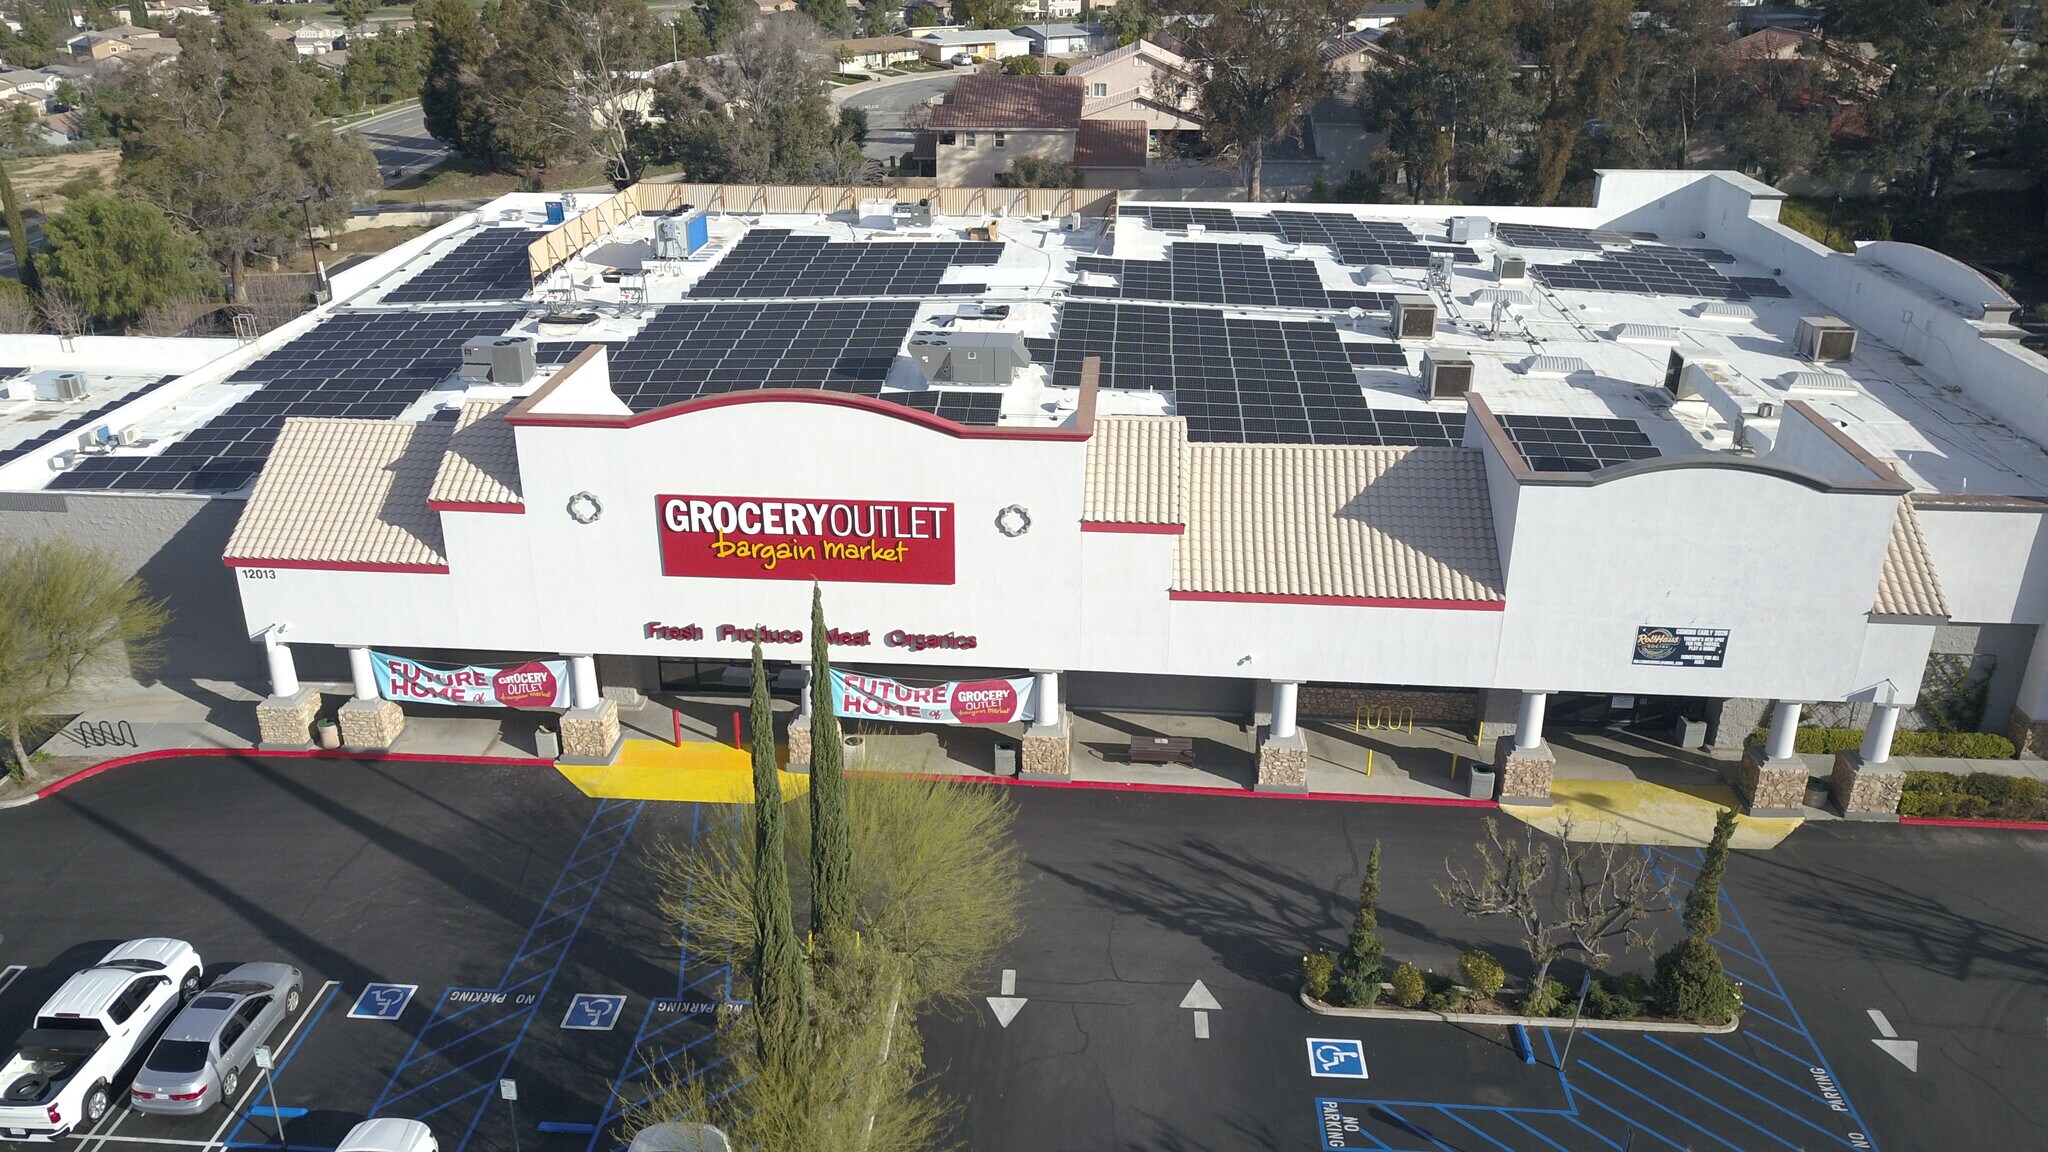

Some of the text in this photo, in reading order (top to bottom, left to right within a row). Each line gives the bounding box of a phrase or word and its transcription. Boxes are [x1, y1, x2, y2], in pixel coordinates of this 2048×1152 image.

[711, 527, 909, 570] bargain market
[242, 569, 276, 579] 12013
[645, 621, 703, 641] Fresh
[719, 624, 803, 644] Produce
[887, 629, 977, 651] Organics
[387, 660, 489, 687] FUTURE
[498, 672, 548, 684] GROCERY
[391, 678, 466, 702] HOME
[507, 683, 543, 695] OUTLET
[843, 675, 948, 704] FUTURE
[958, 689, 1010, 703] GROCERY
[843, 694, 921, 718] HOME
[965, 698, 1003, 711] OUTLET
[450, 991, 536, 1004] NO PARKING
[658, 1002, 715, 1013] PARKING
[1809, 1067, 1870, 1148] NO PARKING
[1322, 1101, 1360, 1147] NO PARKING
